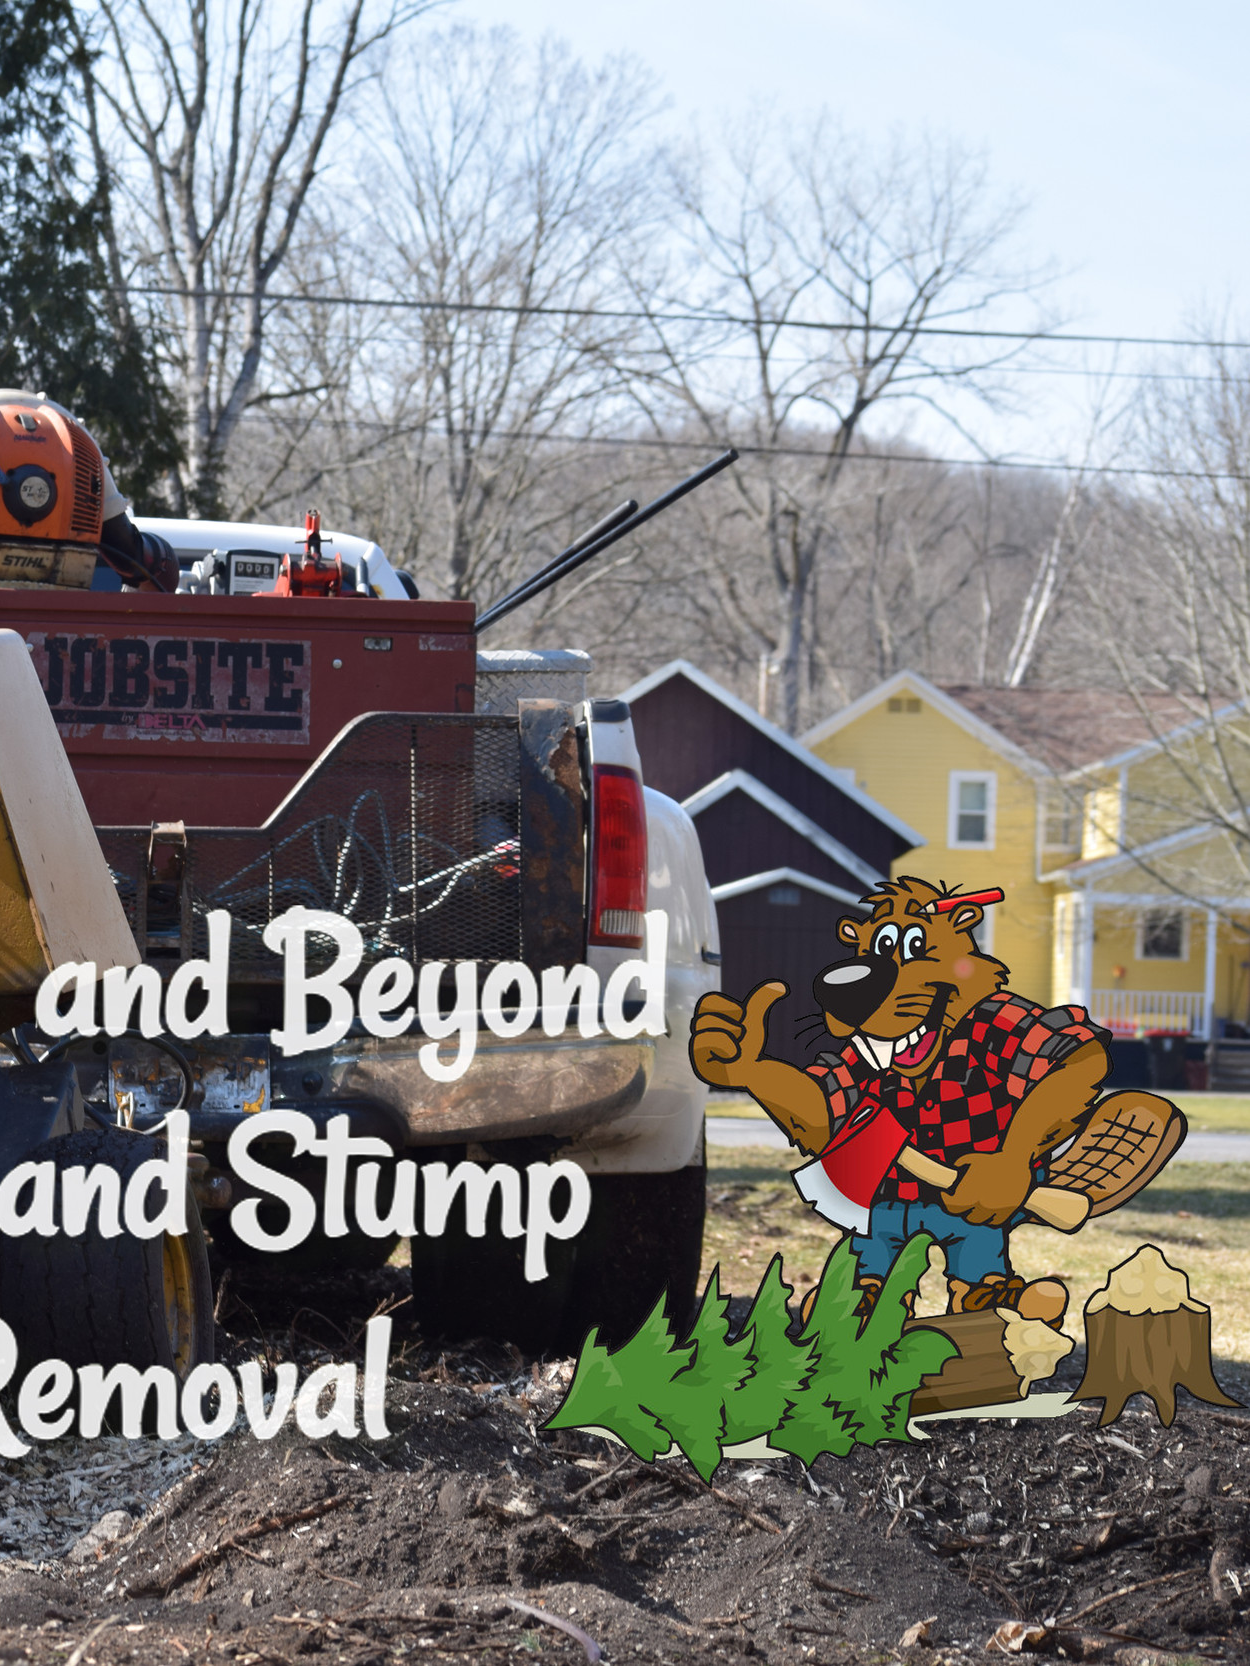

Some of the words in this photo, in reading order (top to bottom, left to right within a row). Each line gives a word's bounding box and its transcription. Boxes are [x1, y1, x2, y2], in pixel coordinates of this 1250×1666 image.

[2, 554, 48, 569] STIHL
[40, 637, 305, 712] JOBSITE
[136, 712, 207, 730] DELTA
